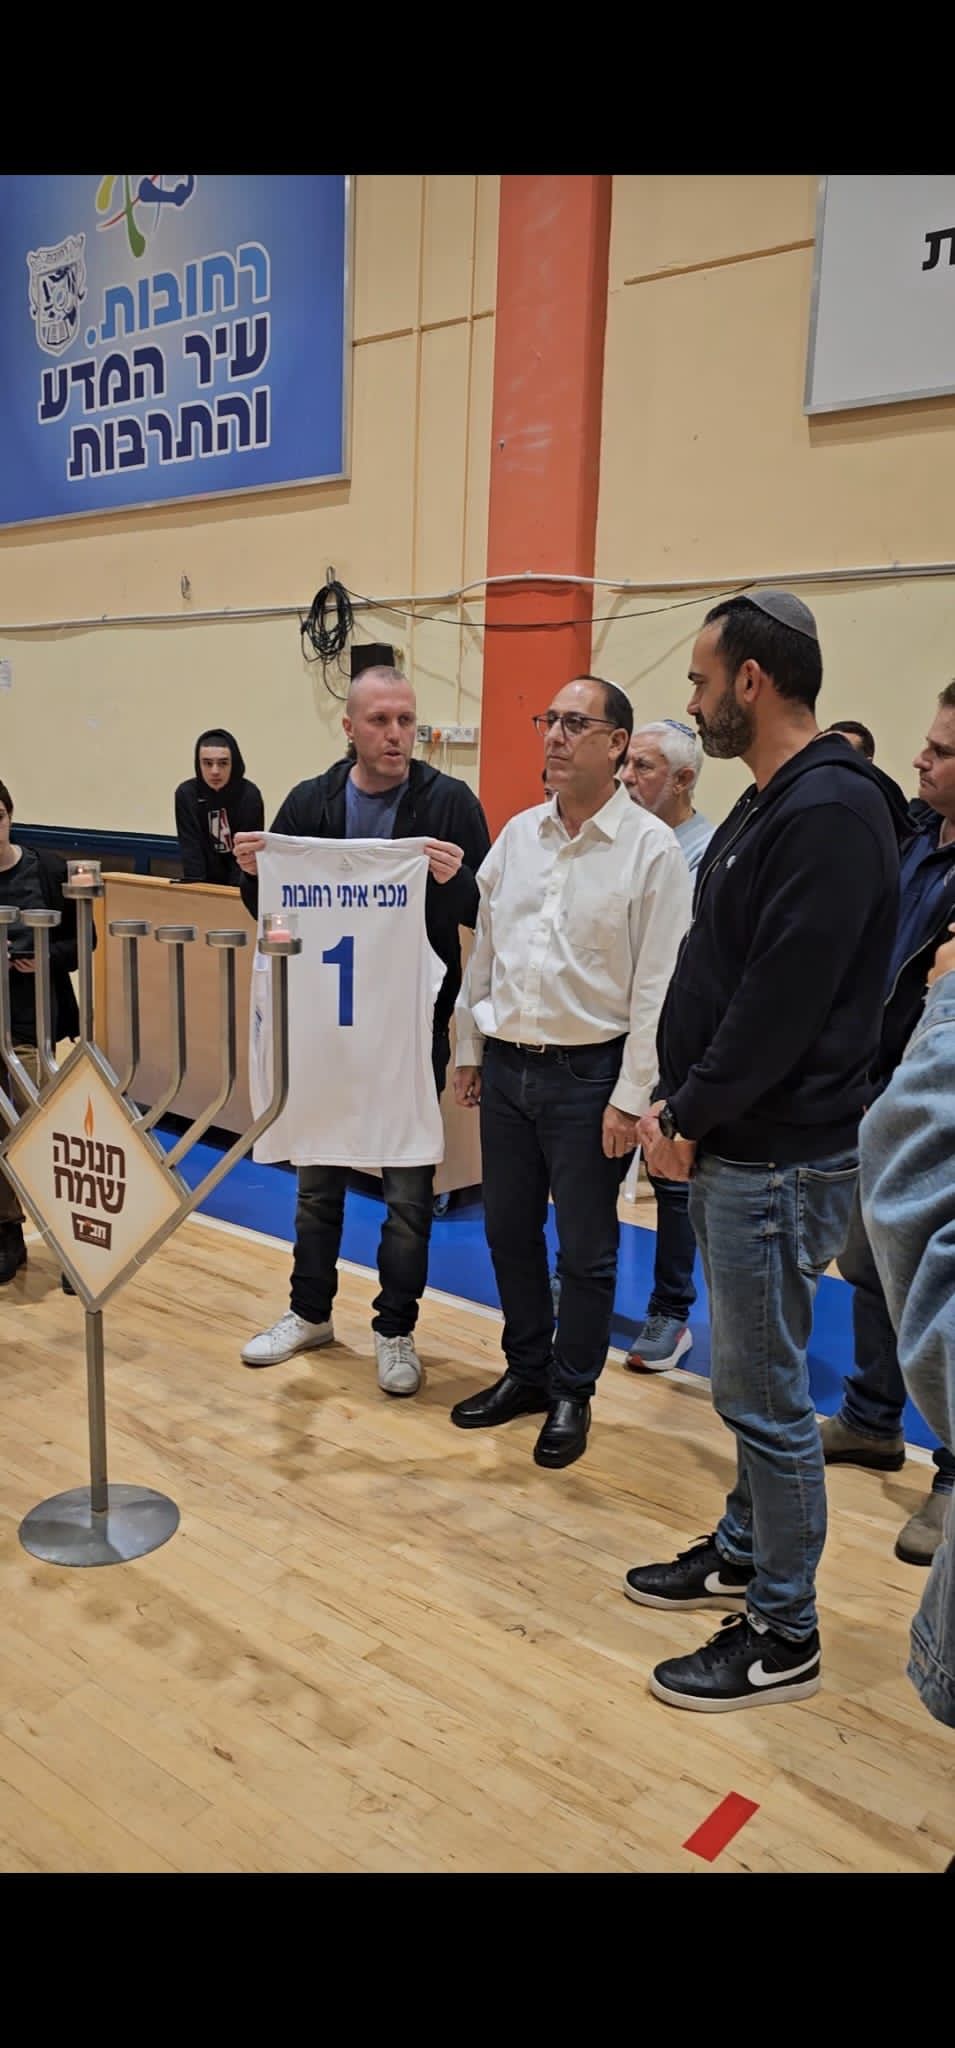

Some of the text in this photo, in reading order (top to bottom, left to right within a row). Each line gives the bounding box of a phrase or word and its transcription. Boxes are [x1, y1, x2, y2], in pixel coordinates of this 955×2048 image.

[40, 316, 268, 420] עיר המדע
[69, 390, 268, 477] והתרבות
[282, 884, 407, 908] מכבי איתי רחובות
[321, 935, 354, 1027] 1
[52, 1132, 126, 1179] חנוכה
[53, 1166, 126, 1214] שמח
